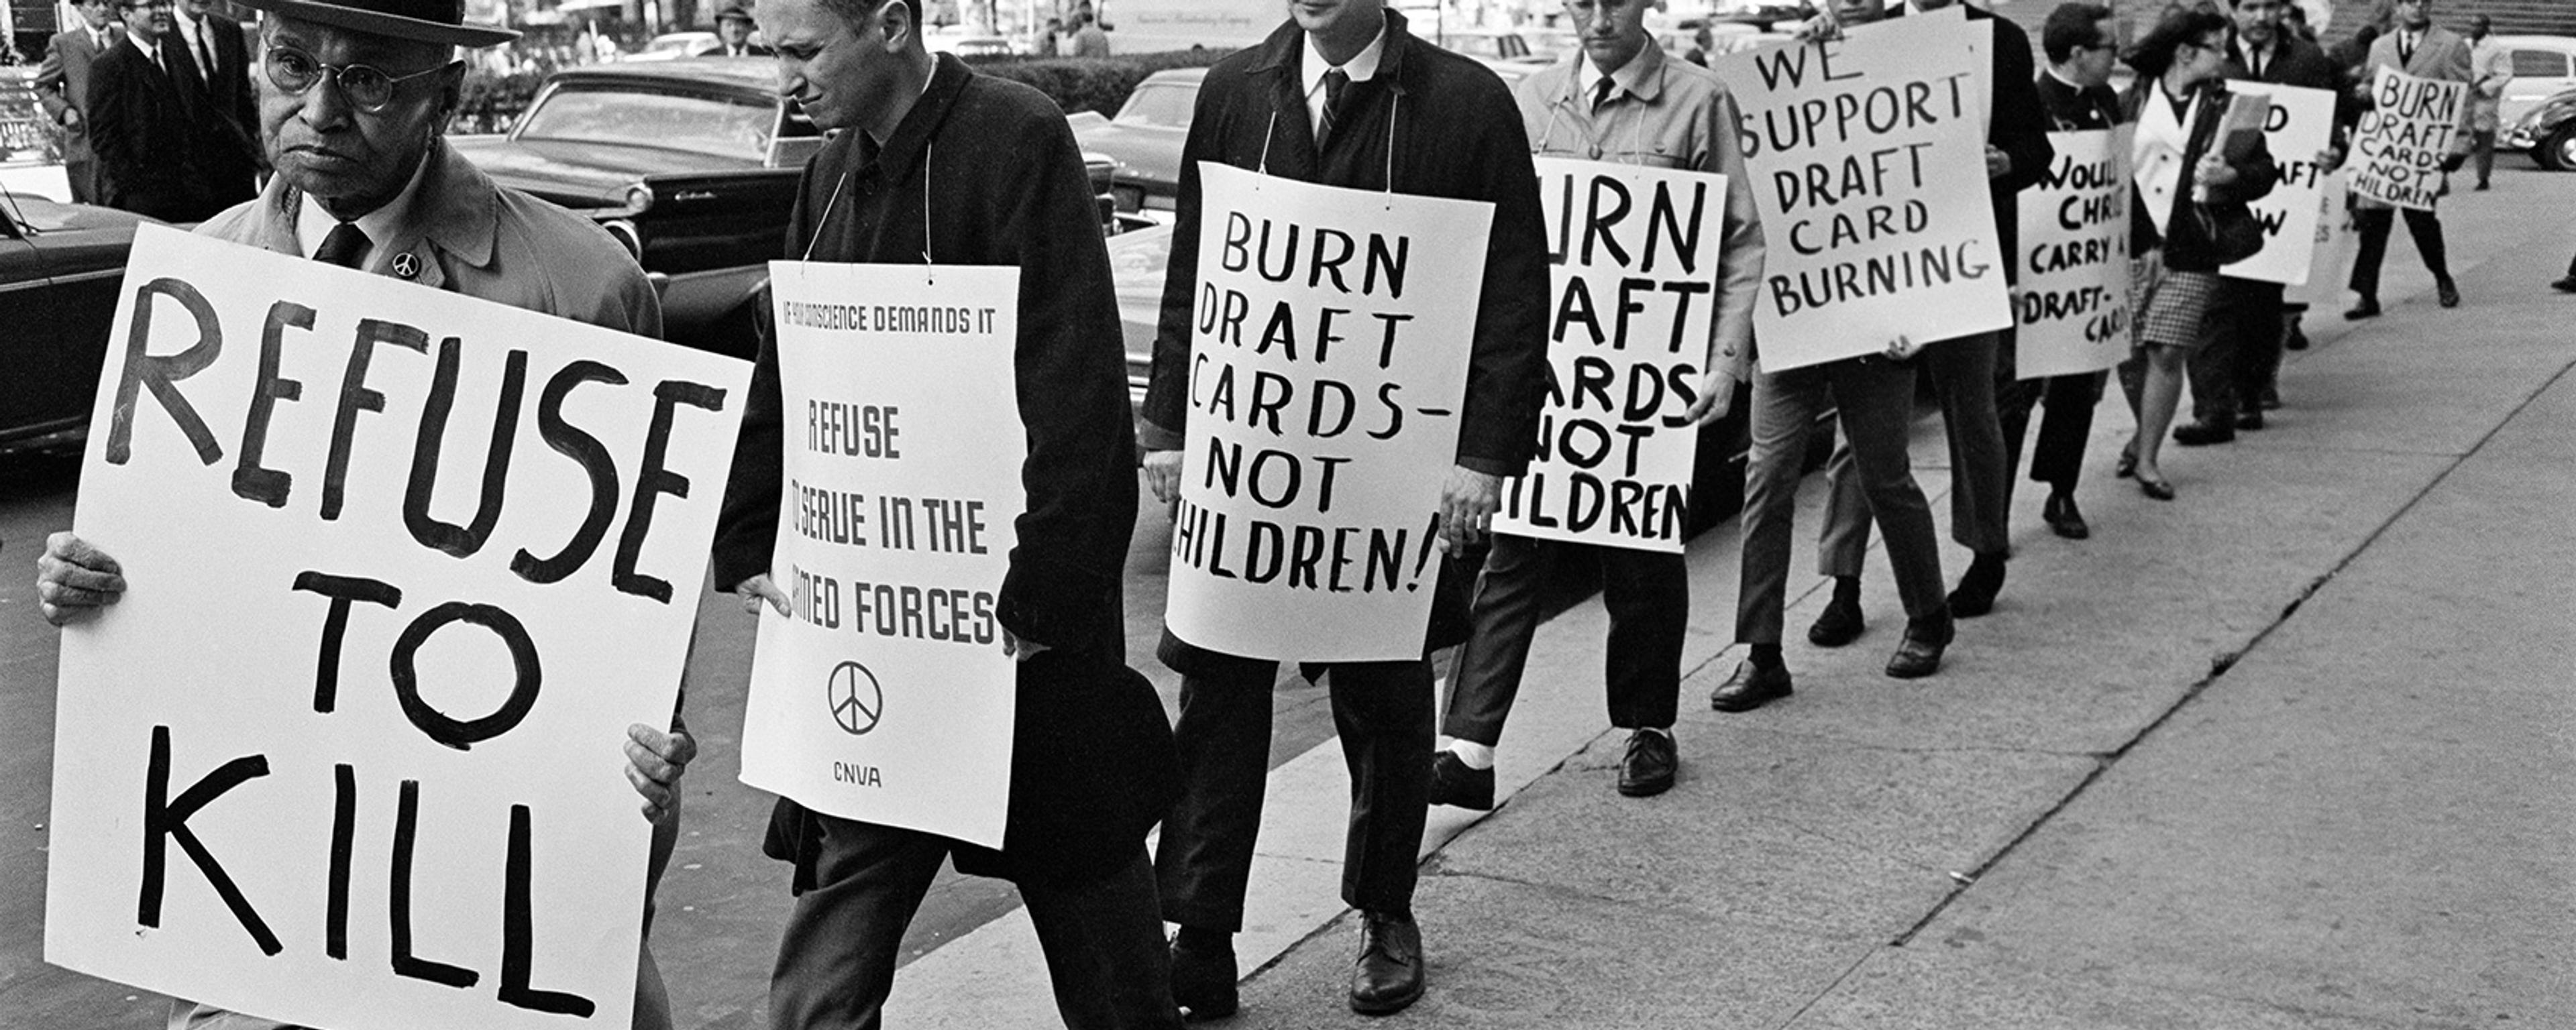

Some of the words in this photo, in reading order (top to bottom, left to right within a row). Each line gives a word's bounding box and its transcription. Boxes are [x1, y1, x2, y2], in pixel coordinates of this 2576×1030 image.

[1755, 36, 1864, 92] WE
[2381, 74, 2459, 122] BURN
[1741, 72, 1971, 159] SUPPORT
[2361, 111, 2453, 150] DRAFT
[1773, 142, 1934, 215] DRAFT
[2039, 155, 2117, 190] WOUL
[2360, 137, 2448, 171] CARDS
[2368, 161, 2432, 189] NOT
[1222, 211, 1409, 300] BURN
[1537, 174, 1707, 275] URN
[1789, 199, 1928, 255] CARD
[2030, 236, 2111, 274] CARRY
[1552, 275, 1710, 353] AFT
[1768, 239, 1990, 318] BURNING
[873, 305, 971, 334] DEMANDS
[978, 308, 996, 335] IT
[1199, 281, 1415, 369] DRAFT
[105, 277, 728, 604] REFUSE
[809, 399, 900, 459] REFUSE
[1205, 436, 1352, 513] NOT
[1509, 471, 1692, 545] ILDREN
[802, 485, 867, 547] SERVE
[879, 495, 915, 551] IN
[922, 498, 988, 555] THE
[1176, 498, 1440, 593] HILDREN!
[855, 581, 994, 645] FORCES
[292, 570, 542, 750] TO
[833, 760, 882, 789] CNVA
[138, 725, 596, 1018] KILL
